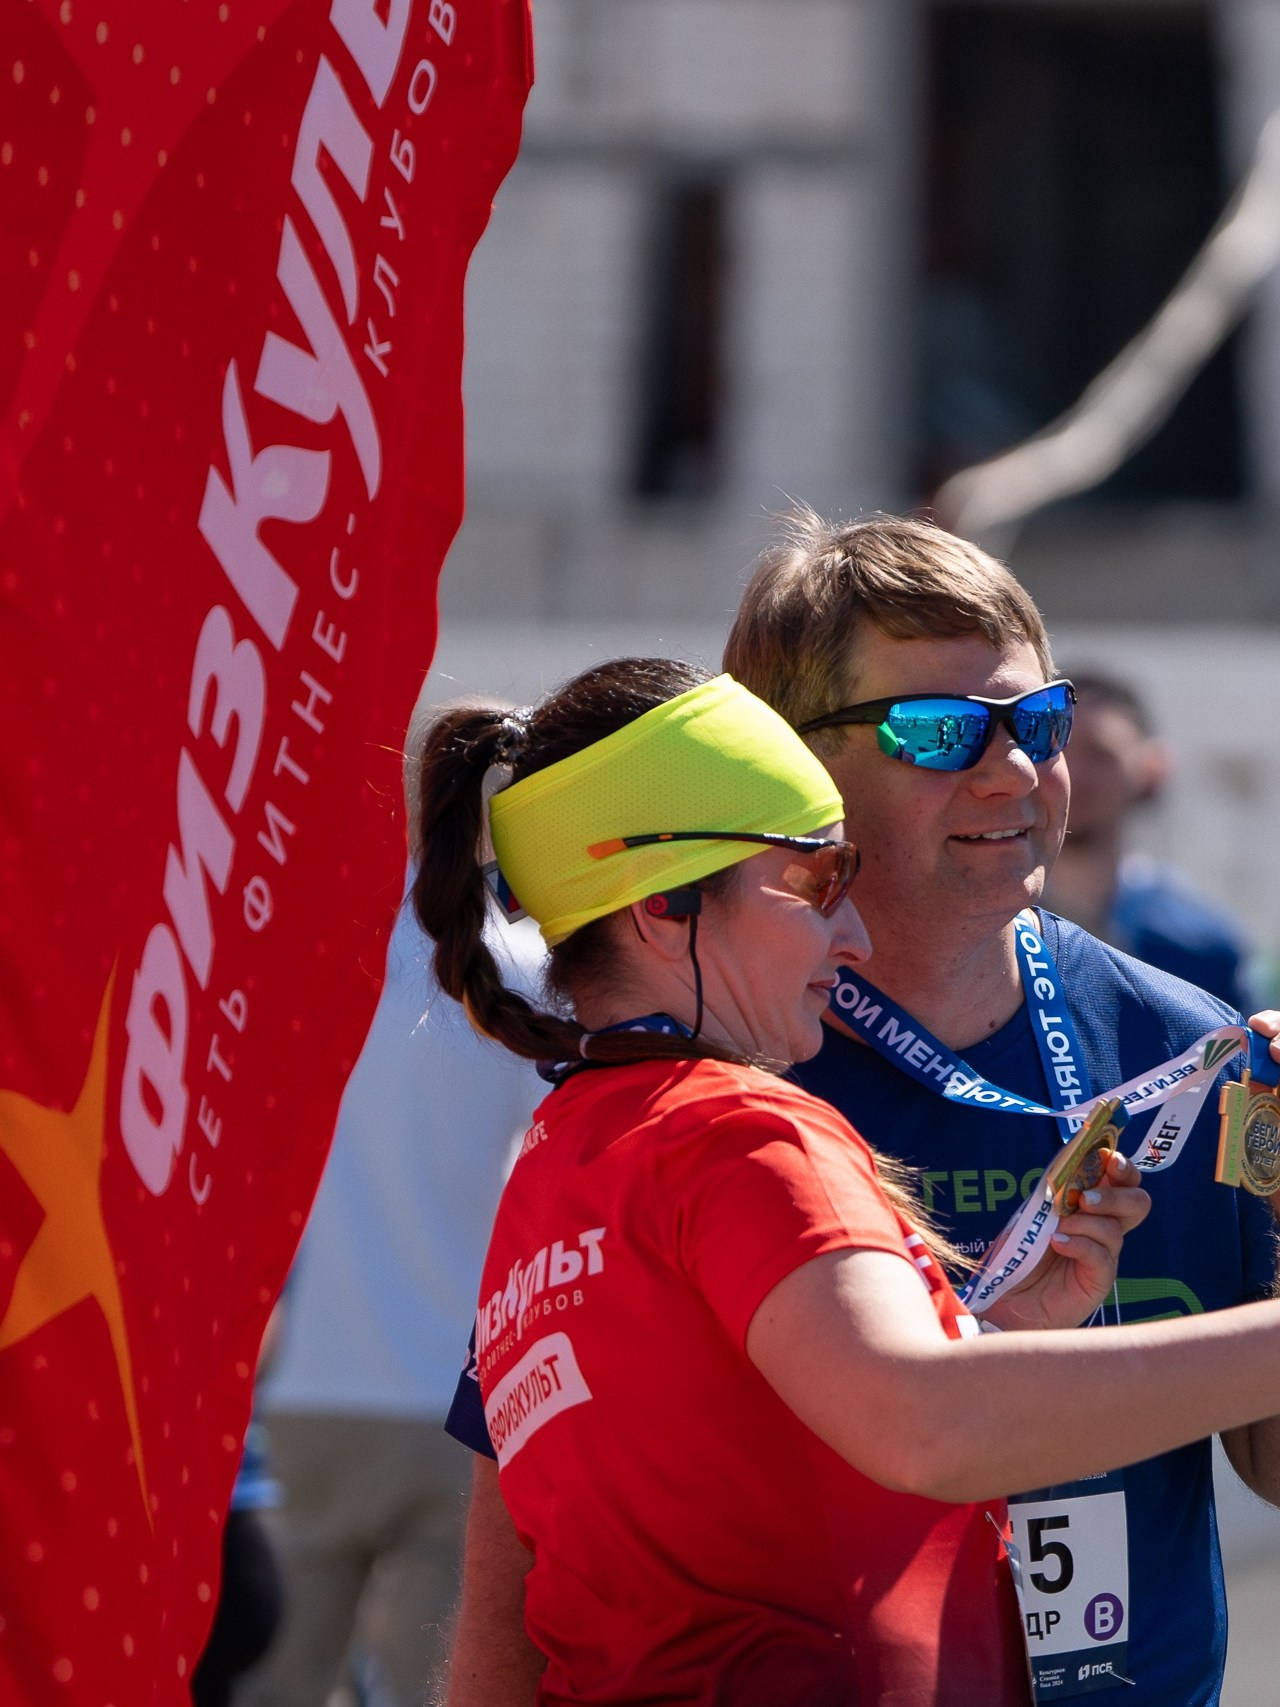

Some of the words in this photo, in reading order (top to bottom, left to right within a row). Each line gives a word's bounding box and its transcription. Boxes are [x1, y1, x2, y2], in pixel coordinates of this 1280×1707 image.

[189, 989, 249, 1205] СЕТЬ
[877, 1016, 1026, 1108] МЕНЯЮТ
[1009, 1514, 1074, 1594] 5
[1092, 1662, 1113, 1676] ПСБ
